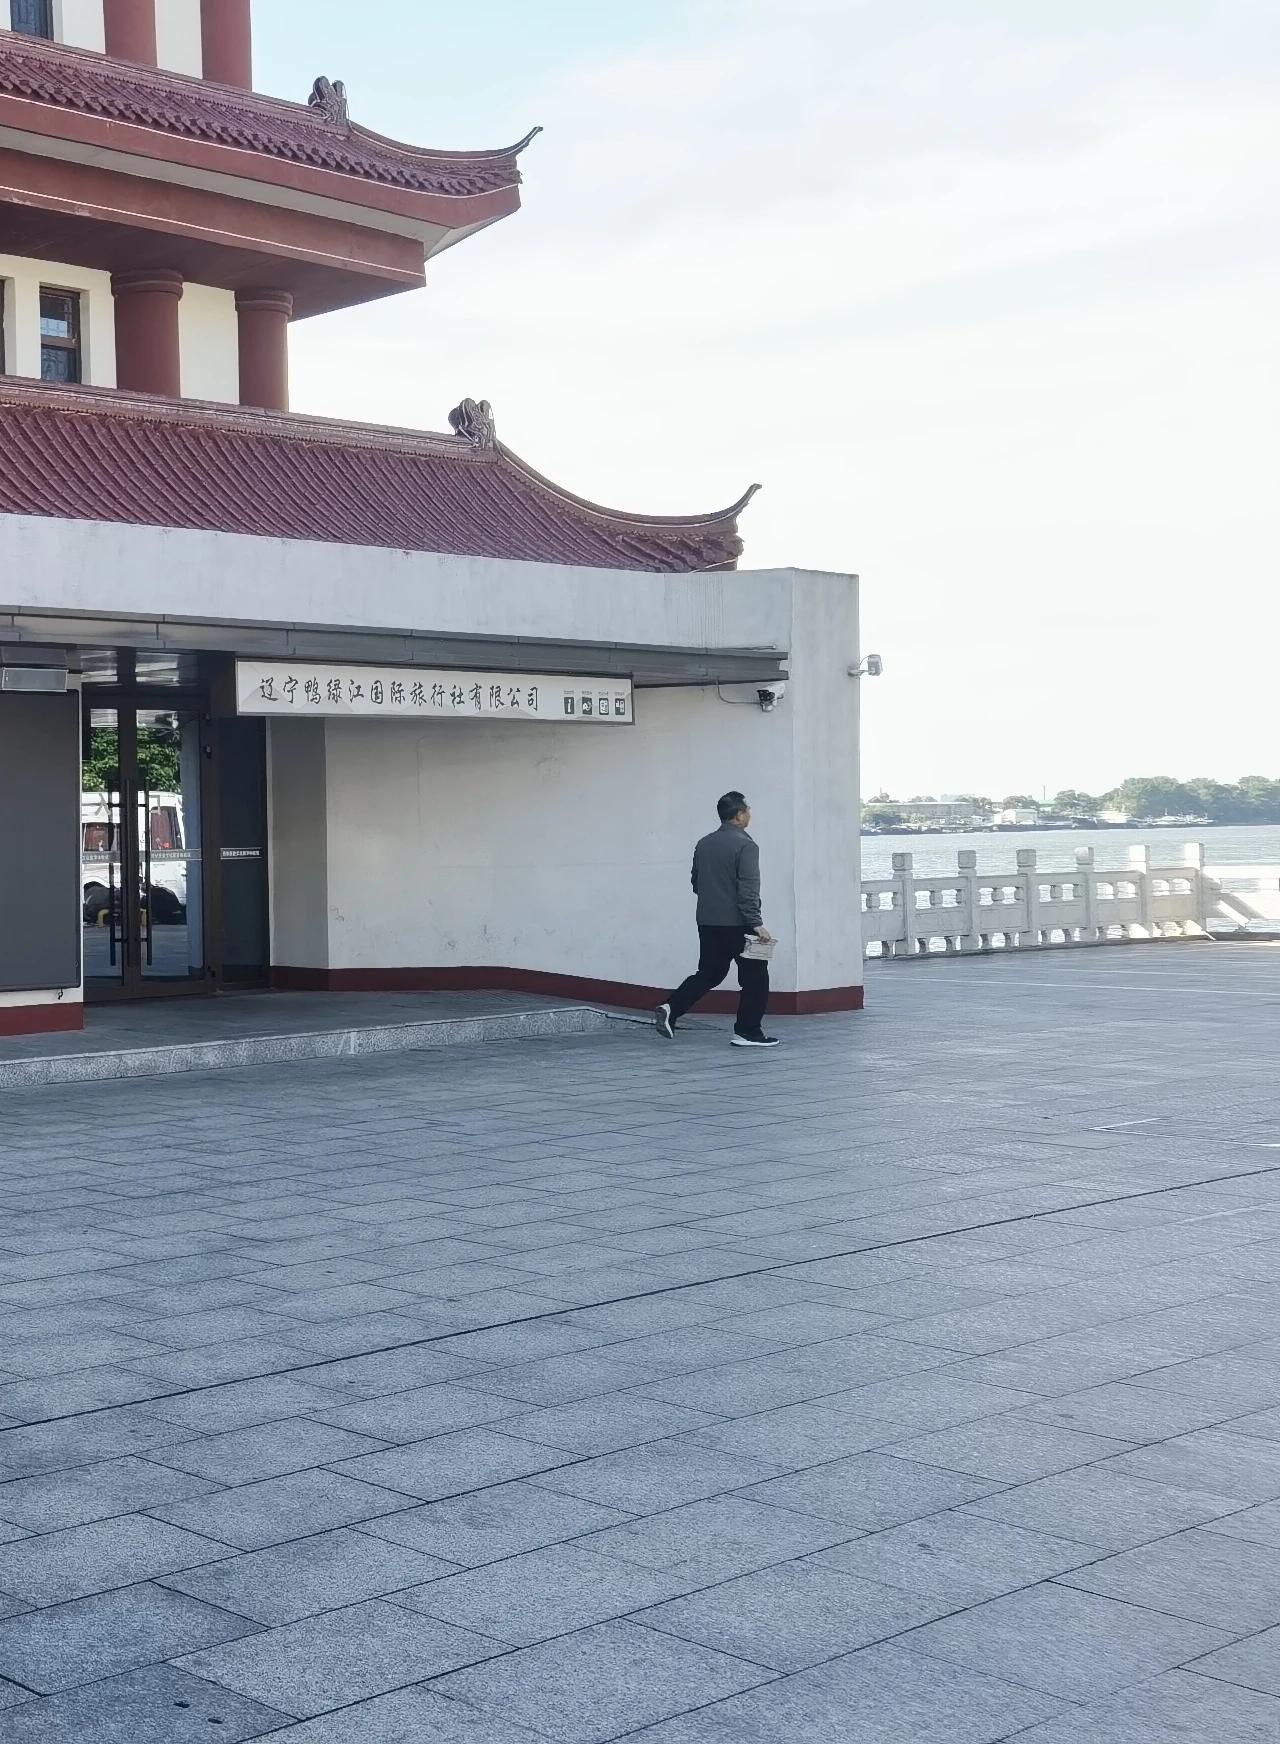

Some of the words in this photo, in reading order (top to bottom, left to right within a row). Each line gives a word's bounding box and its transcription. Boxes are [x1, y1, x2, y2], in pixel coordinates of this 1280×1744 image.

[259, 675, 541, 712] 辽宁鸭绿江国际旅行社有限公司
